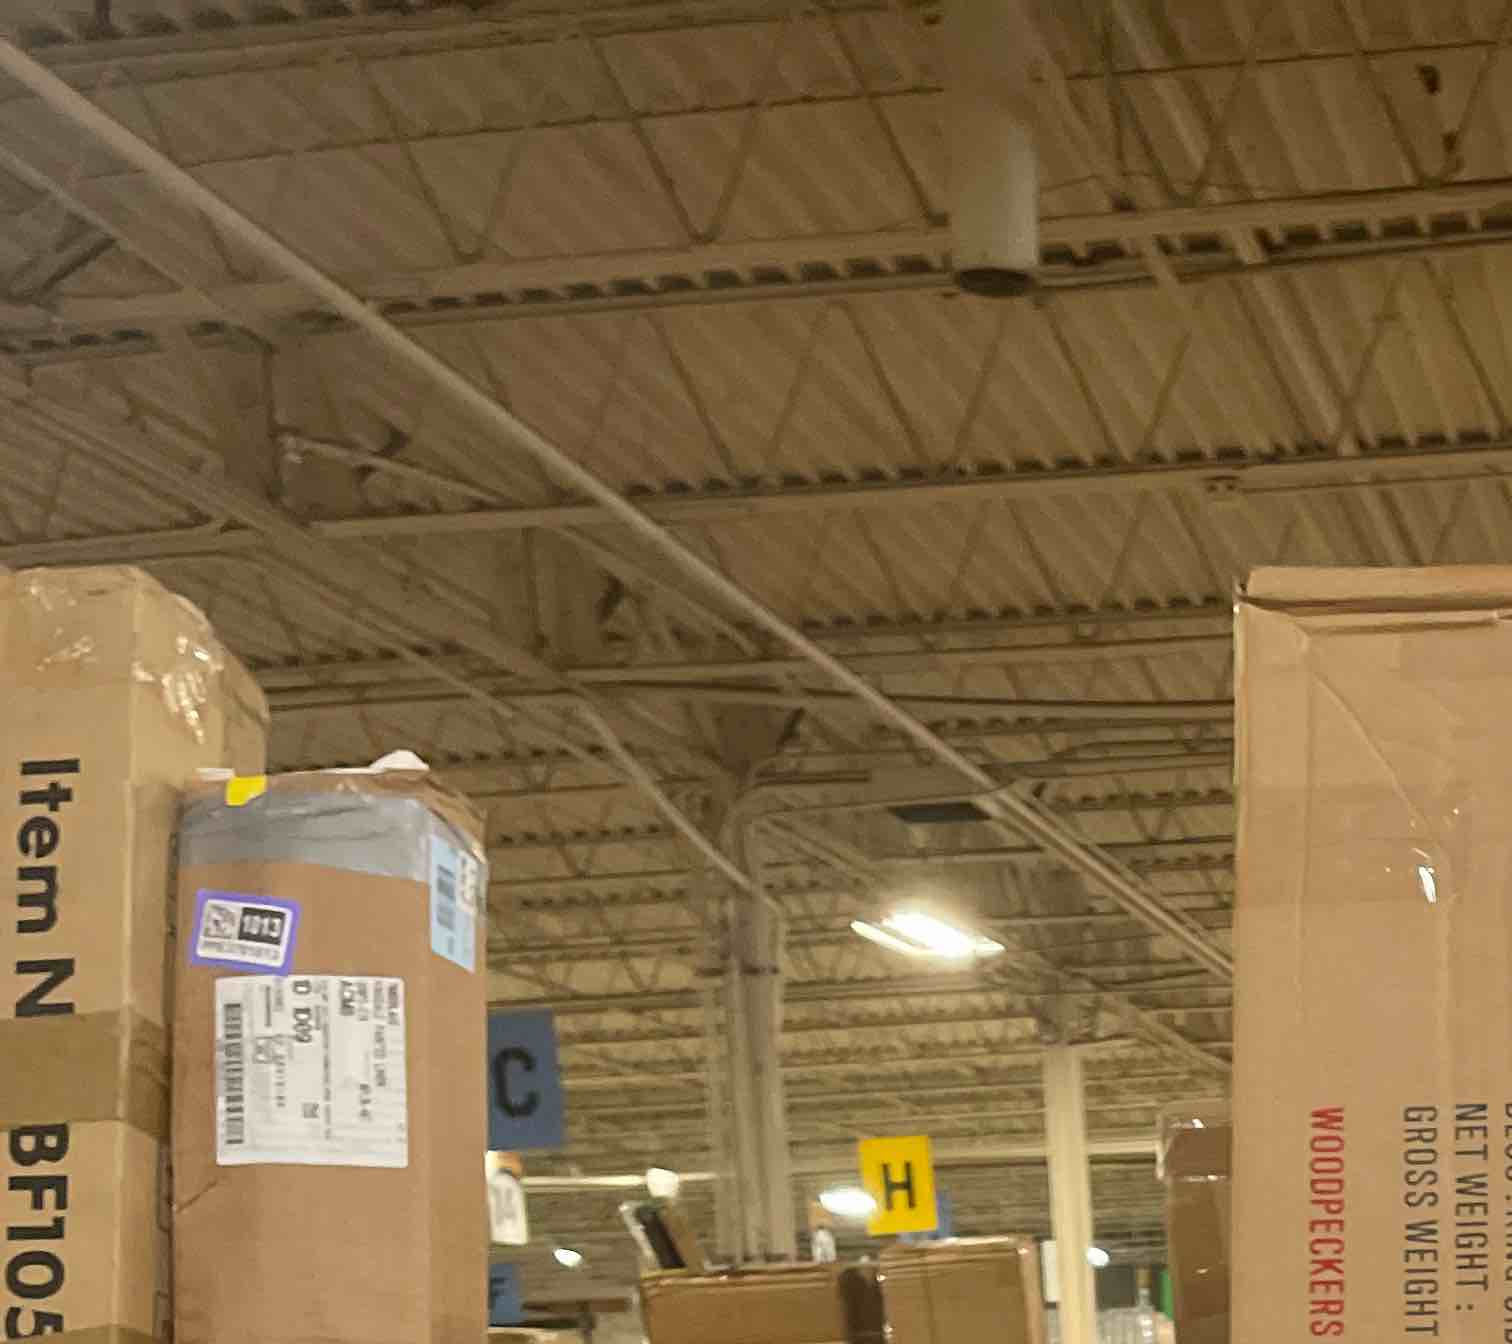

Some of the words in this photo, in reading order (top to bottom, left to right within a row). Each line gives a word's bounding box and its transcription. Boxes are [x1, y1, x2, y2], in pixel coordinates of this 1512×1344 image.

[16, 758, 81, 935] Item
[490, 1046, 538, 1119] C
[1404, 1105, 1439, 1209] GROSS
[1455, 1102, 1489, 1162] NET
[883, 1161, 916, 1211] H
[1309, 1106, 1346, 1337] WOODPECKERS
